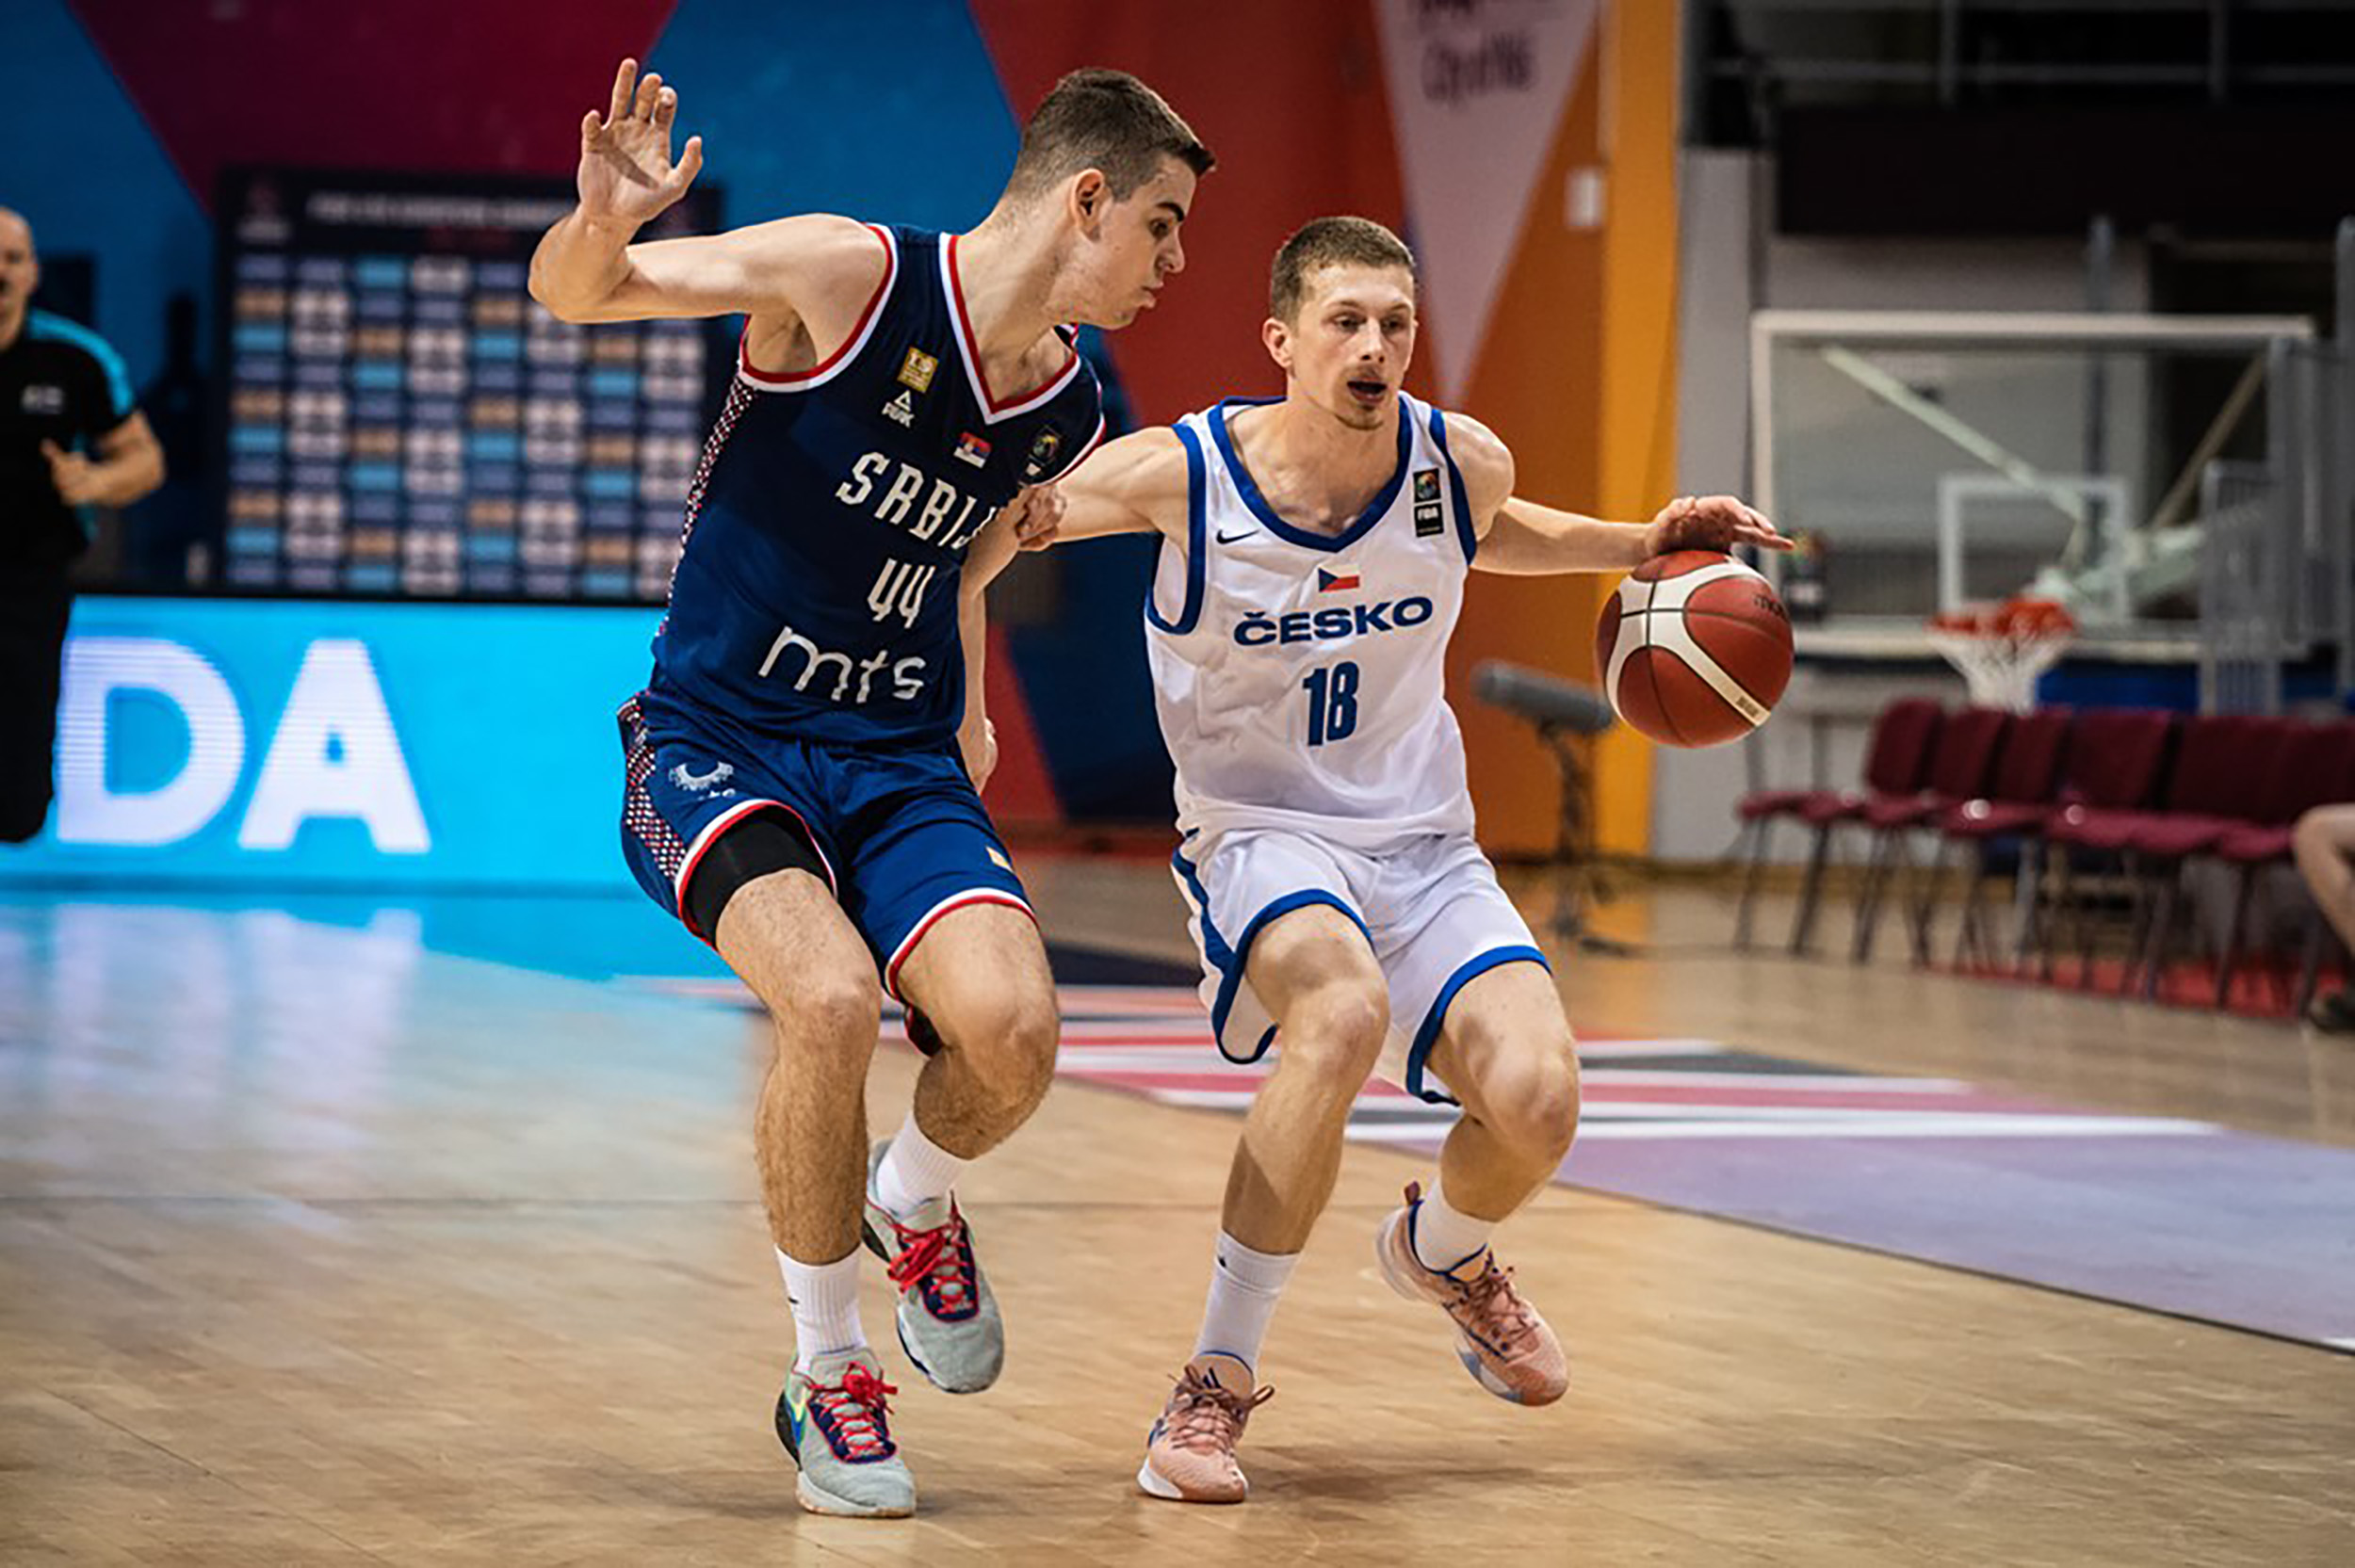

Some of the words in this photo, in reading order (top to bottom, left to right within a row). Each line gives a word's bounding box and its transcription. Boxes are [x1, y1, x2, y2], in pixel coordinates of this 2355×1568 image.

[867, 558, 936, 629] 44
[1233, 596, 1433, 646] ČESKO
[758, 625, 927, 703] mts
[1302, 661, 1359, 746] 18
[56, 636, 431, 853] DA
